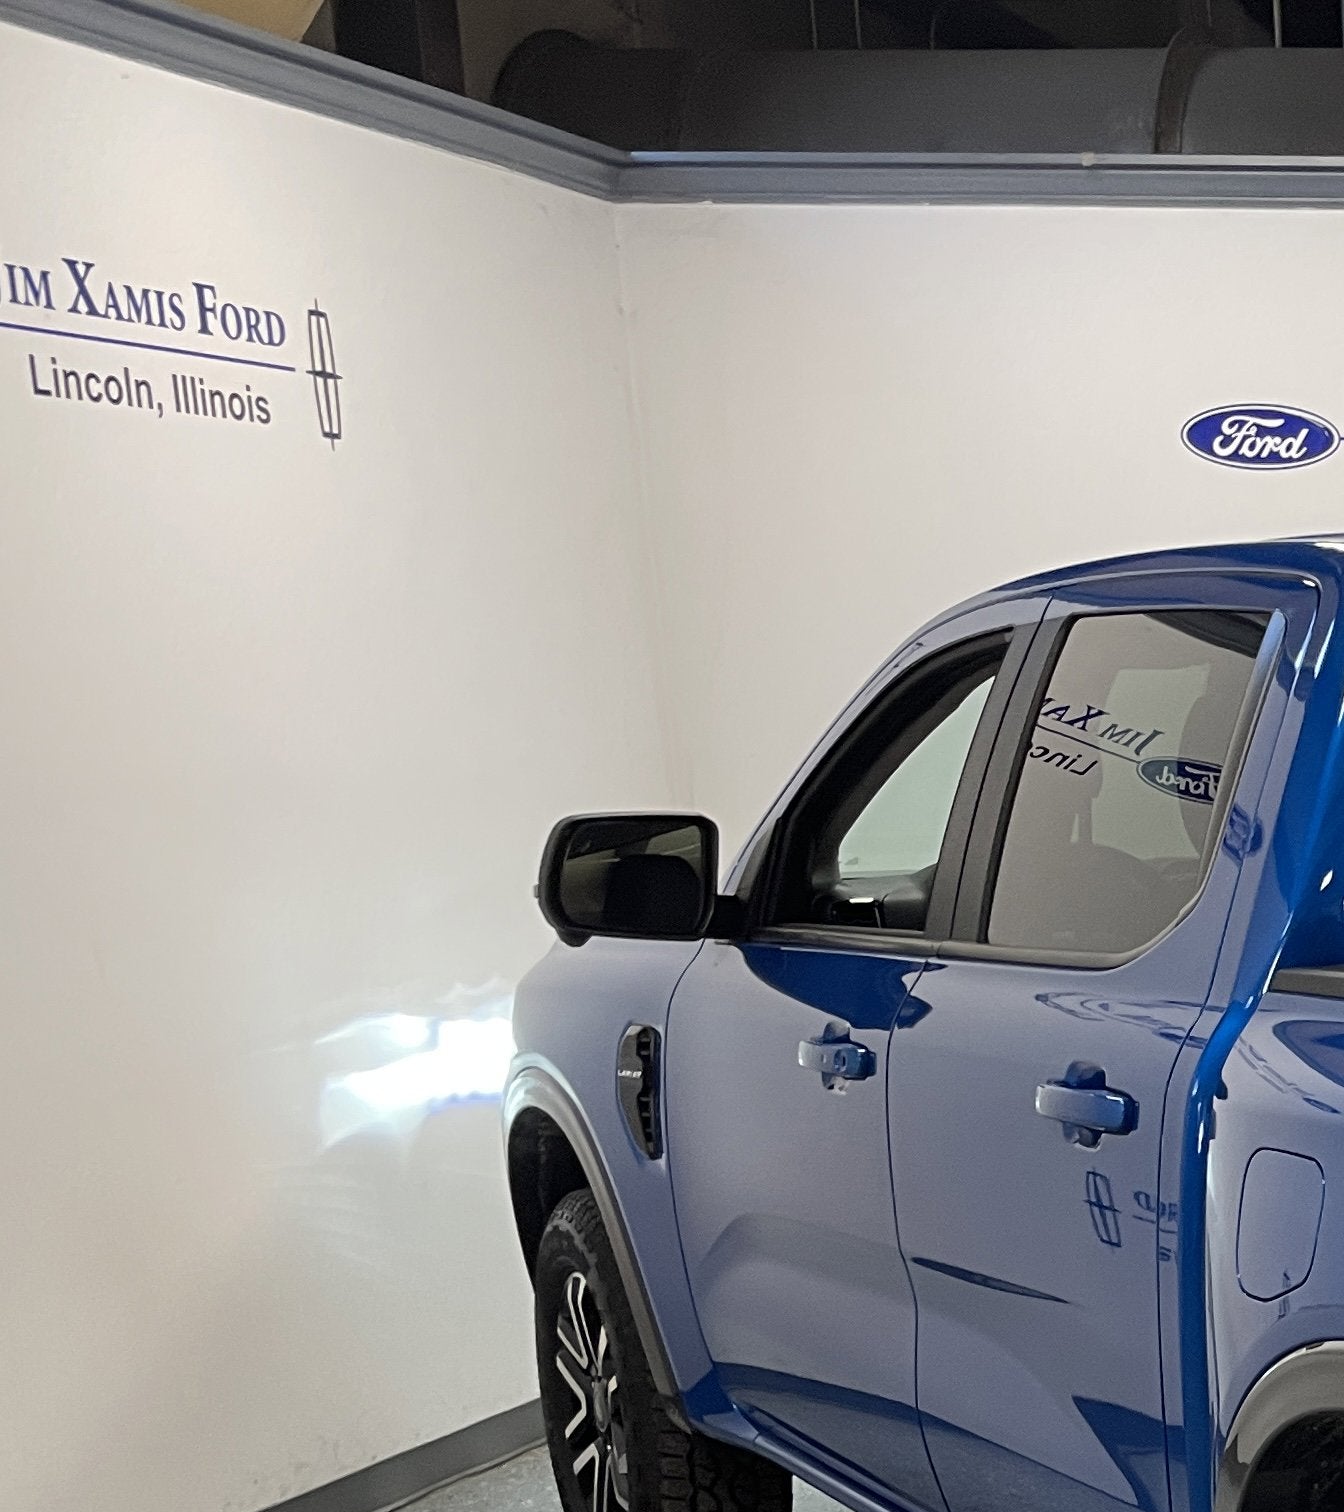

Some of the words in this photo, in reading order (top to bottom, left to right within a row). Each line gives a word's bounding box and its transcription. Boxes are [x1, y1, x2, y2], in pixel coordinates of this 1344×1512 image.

[0, 263, 56, 310] IM
[61, 257, 186, 331] XAMIS
[192, 282, 286, 347] FORD
[29, 354, 163, 418] Lincoln,
[172, 374, 271, 424] Illinois
[1213, 415, 1307, 459] Ford
